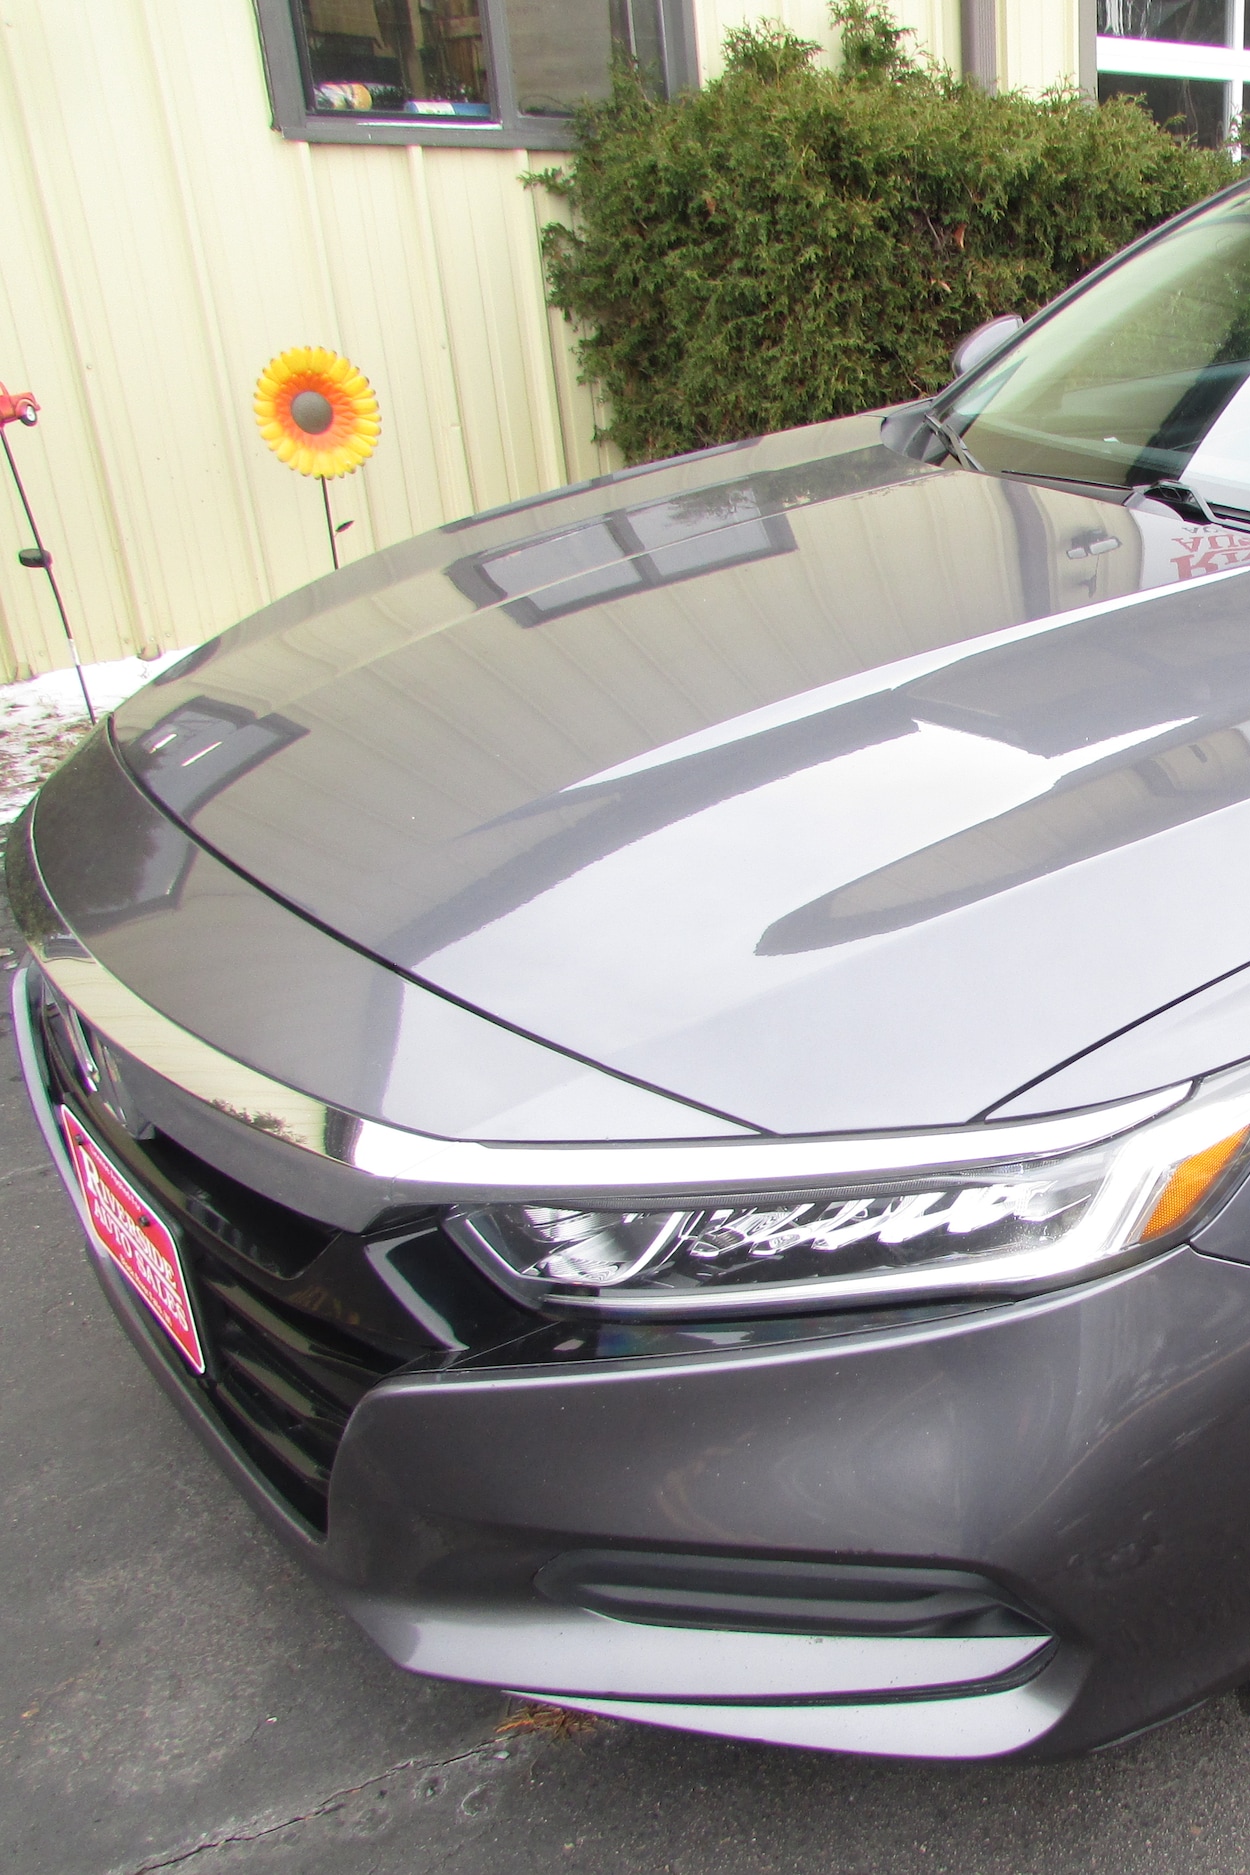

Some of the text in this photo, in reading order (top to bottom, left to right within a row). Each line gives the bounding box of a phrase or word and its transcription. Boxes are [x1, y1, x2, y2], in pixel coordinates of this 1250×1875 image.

[79, 1145, 177, 1290] RIVERSIDE
[94, 1199, 133, 1258] AUTO
[135, 1250, 189, 1332] SALES
